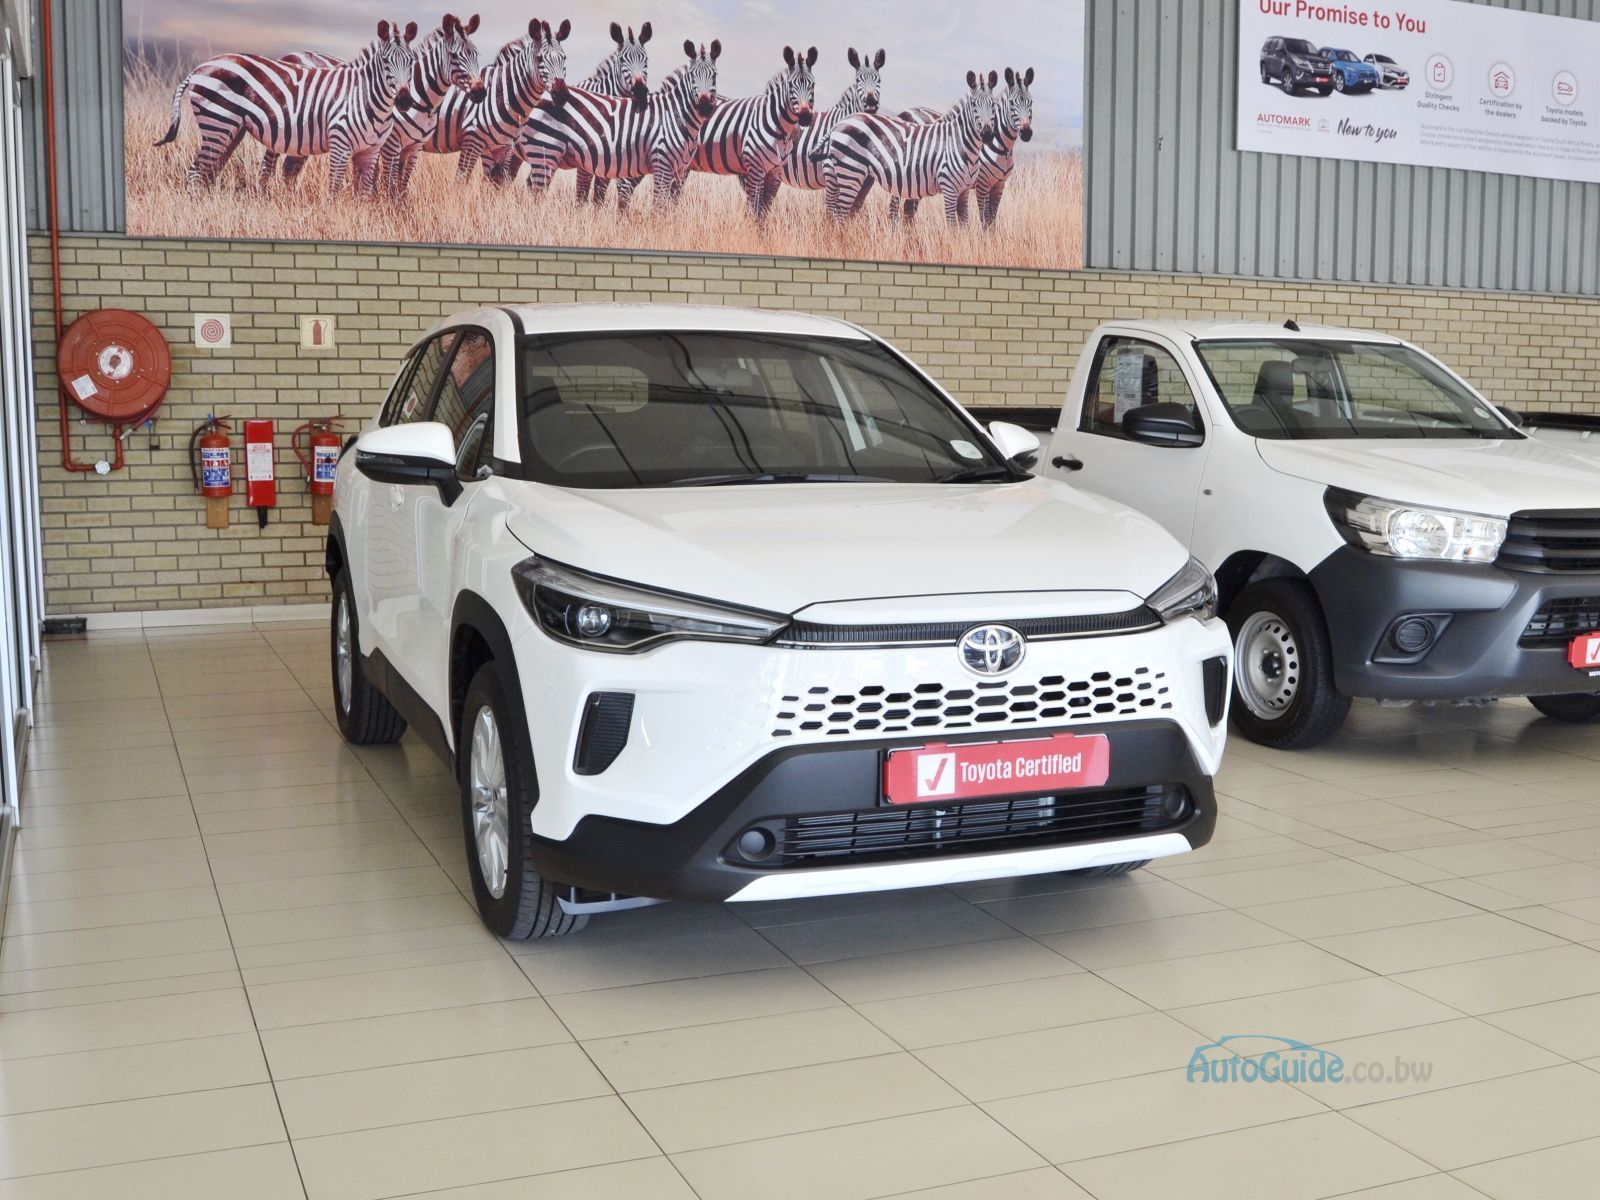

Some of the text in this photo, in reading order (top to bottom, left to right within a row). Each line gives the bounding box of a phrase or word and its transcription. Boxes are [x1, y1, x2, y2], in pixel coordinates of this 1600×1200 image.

[1259, 0, 1426, 33] Our Promise to You
[1425, 91, 1453, 101] Stringent
[1417, 101, 1460, 112] Quality Checks
[1479, 98, 1523, 111] Certification by
[1495, 110, 1517, 119] dealers
[1545, 106, 1584, 117] Toyota models
[1257, 113, 1311, 127] AUTOMARK
[1541, 115, 1587, 128] backed by Toyota
[1363, 123, 1375, 137] to
[1374, 127, 1398, 143] you
[960, 752, 1082, 784] Toyota Certified
